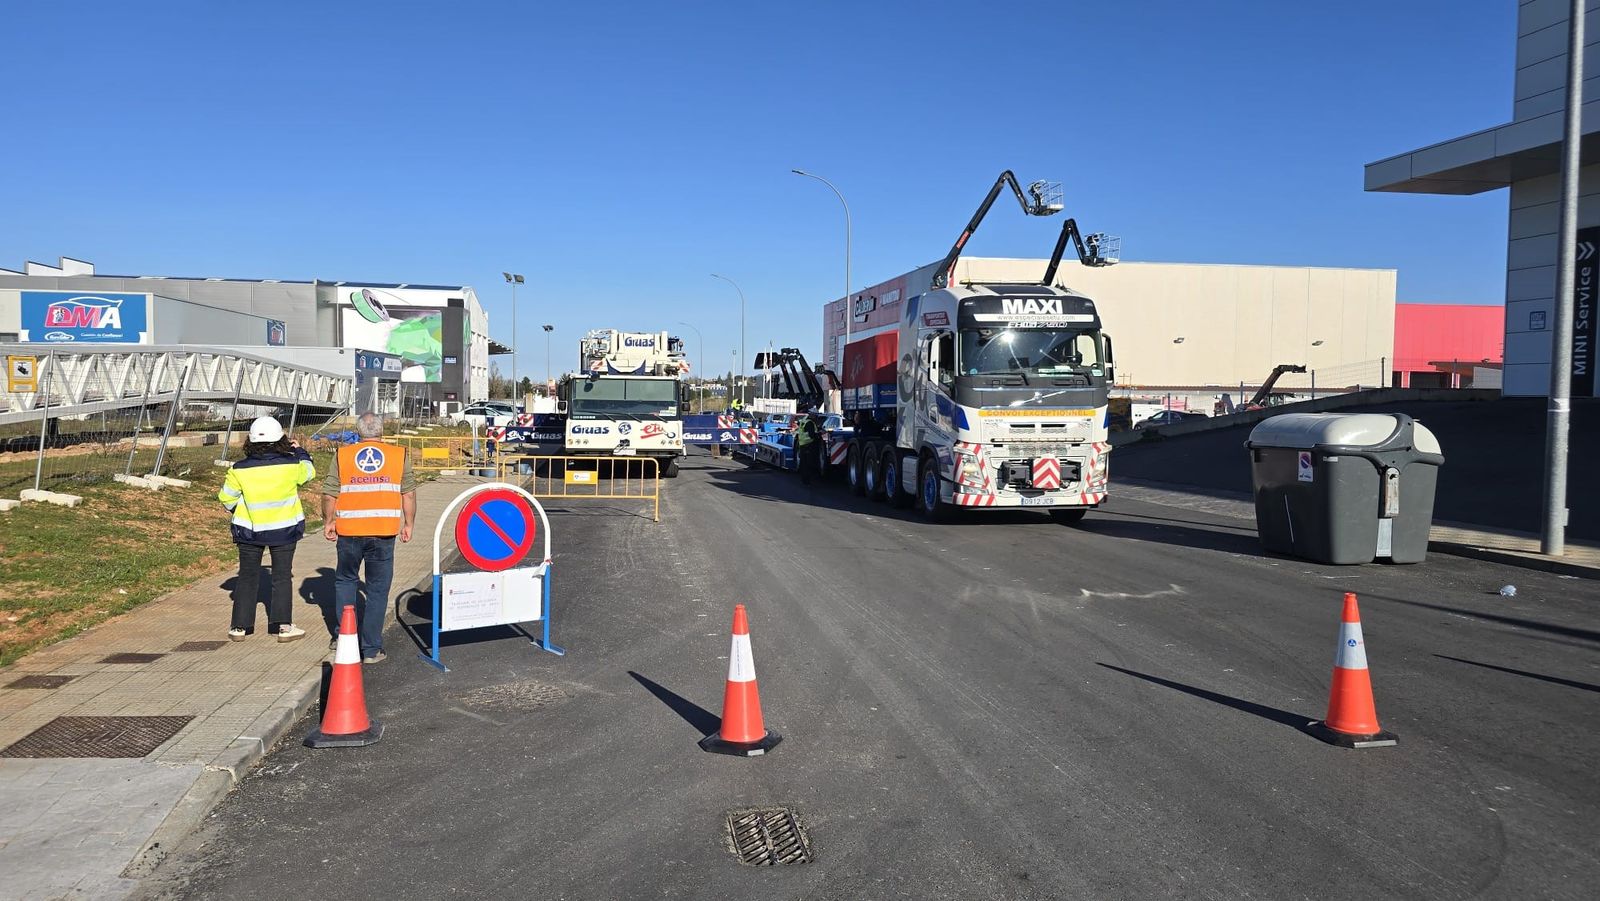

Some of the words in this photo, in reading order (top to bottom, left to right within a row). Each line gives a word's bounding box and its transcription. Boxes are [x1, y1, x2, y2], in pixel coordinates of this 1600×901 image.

[1576, 266, 1592, 330] Service
[1001, 298, 1064, 315] MAXI
[45, 305, 122, 329] DMA
[624, 336, 655, 347] Gruas
[1573, 335, 1588, 375] MINI
[987, 409, 1020, 417] CONVOI
[1023, 409, 1089, 417] EXCEPTIONNEL
[571, 424, 610, 435] Gruas
[531, 432, 563, 440] Gruas
[682, 432, 712, 440] Gruas
[350, 473, 391, 484] aceinsa
